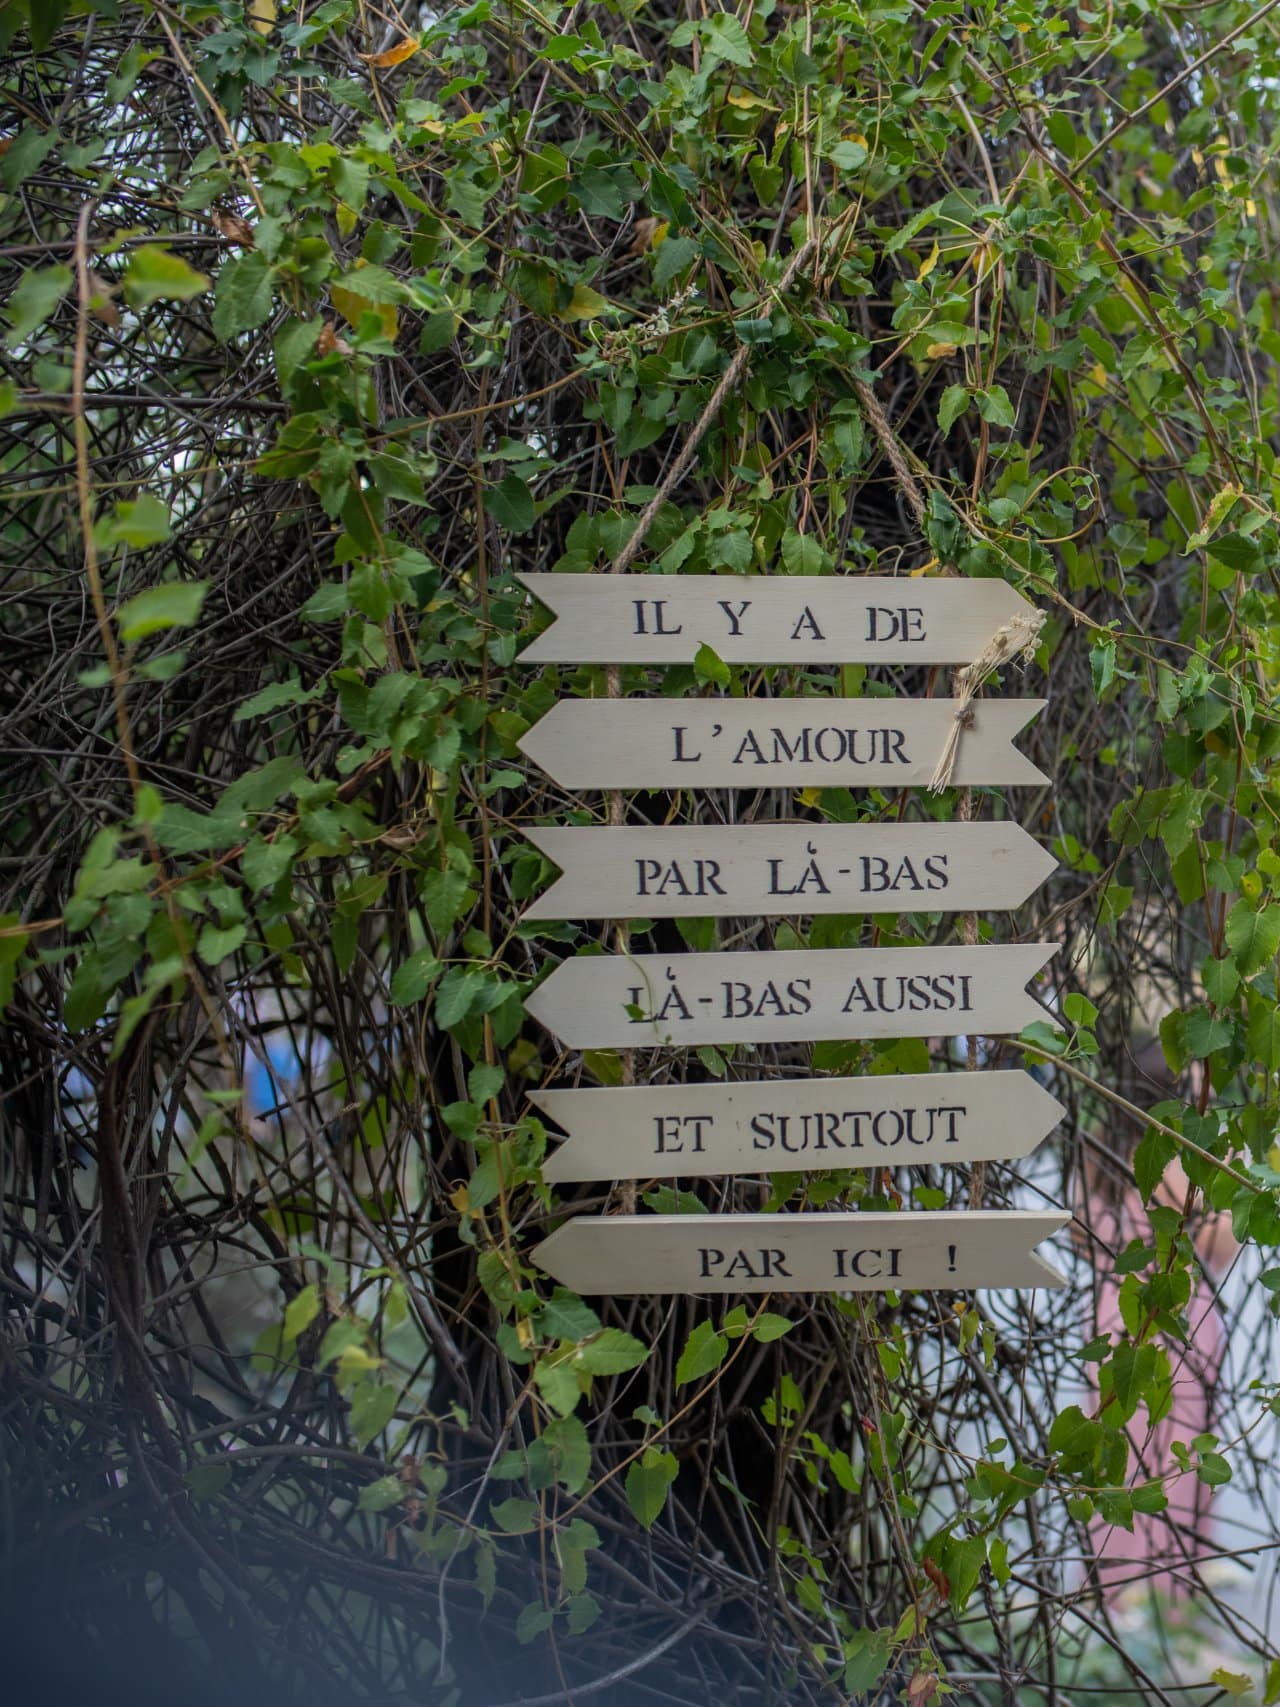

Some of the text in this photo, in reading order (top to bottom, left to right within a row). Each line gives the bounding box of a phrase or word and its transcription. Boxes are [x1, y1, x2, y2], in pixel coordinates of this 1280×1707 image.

[631, 599, 927, 643] IL Y A DE
[670, 723, 913, 765] L'AMOUR
[633, 840, 949, 897] PAR LÀ-BAS
[627, 966, 974, 1024] LÀ-BAS AUSSI
[651, 1105, 968, 1155] ET SURTOUT
[698, 1244, 958, 1278] PAR ICI !
